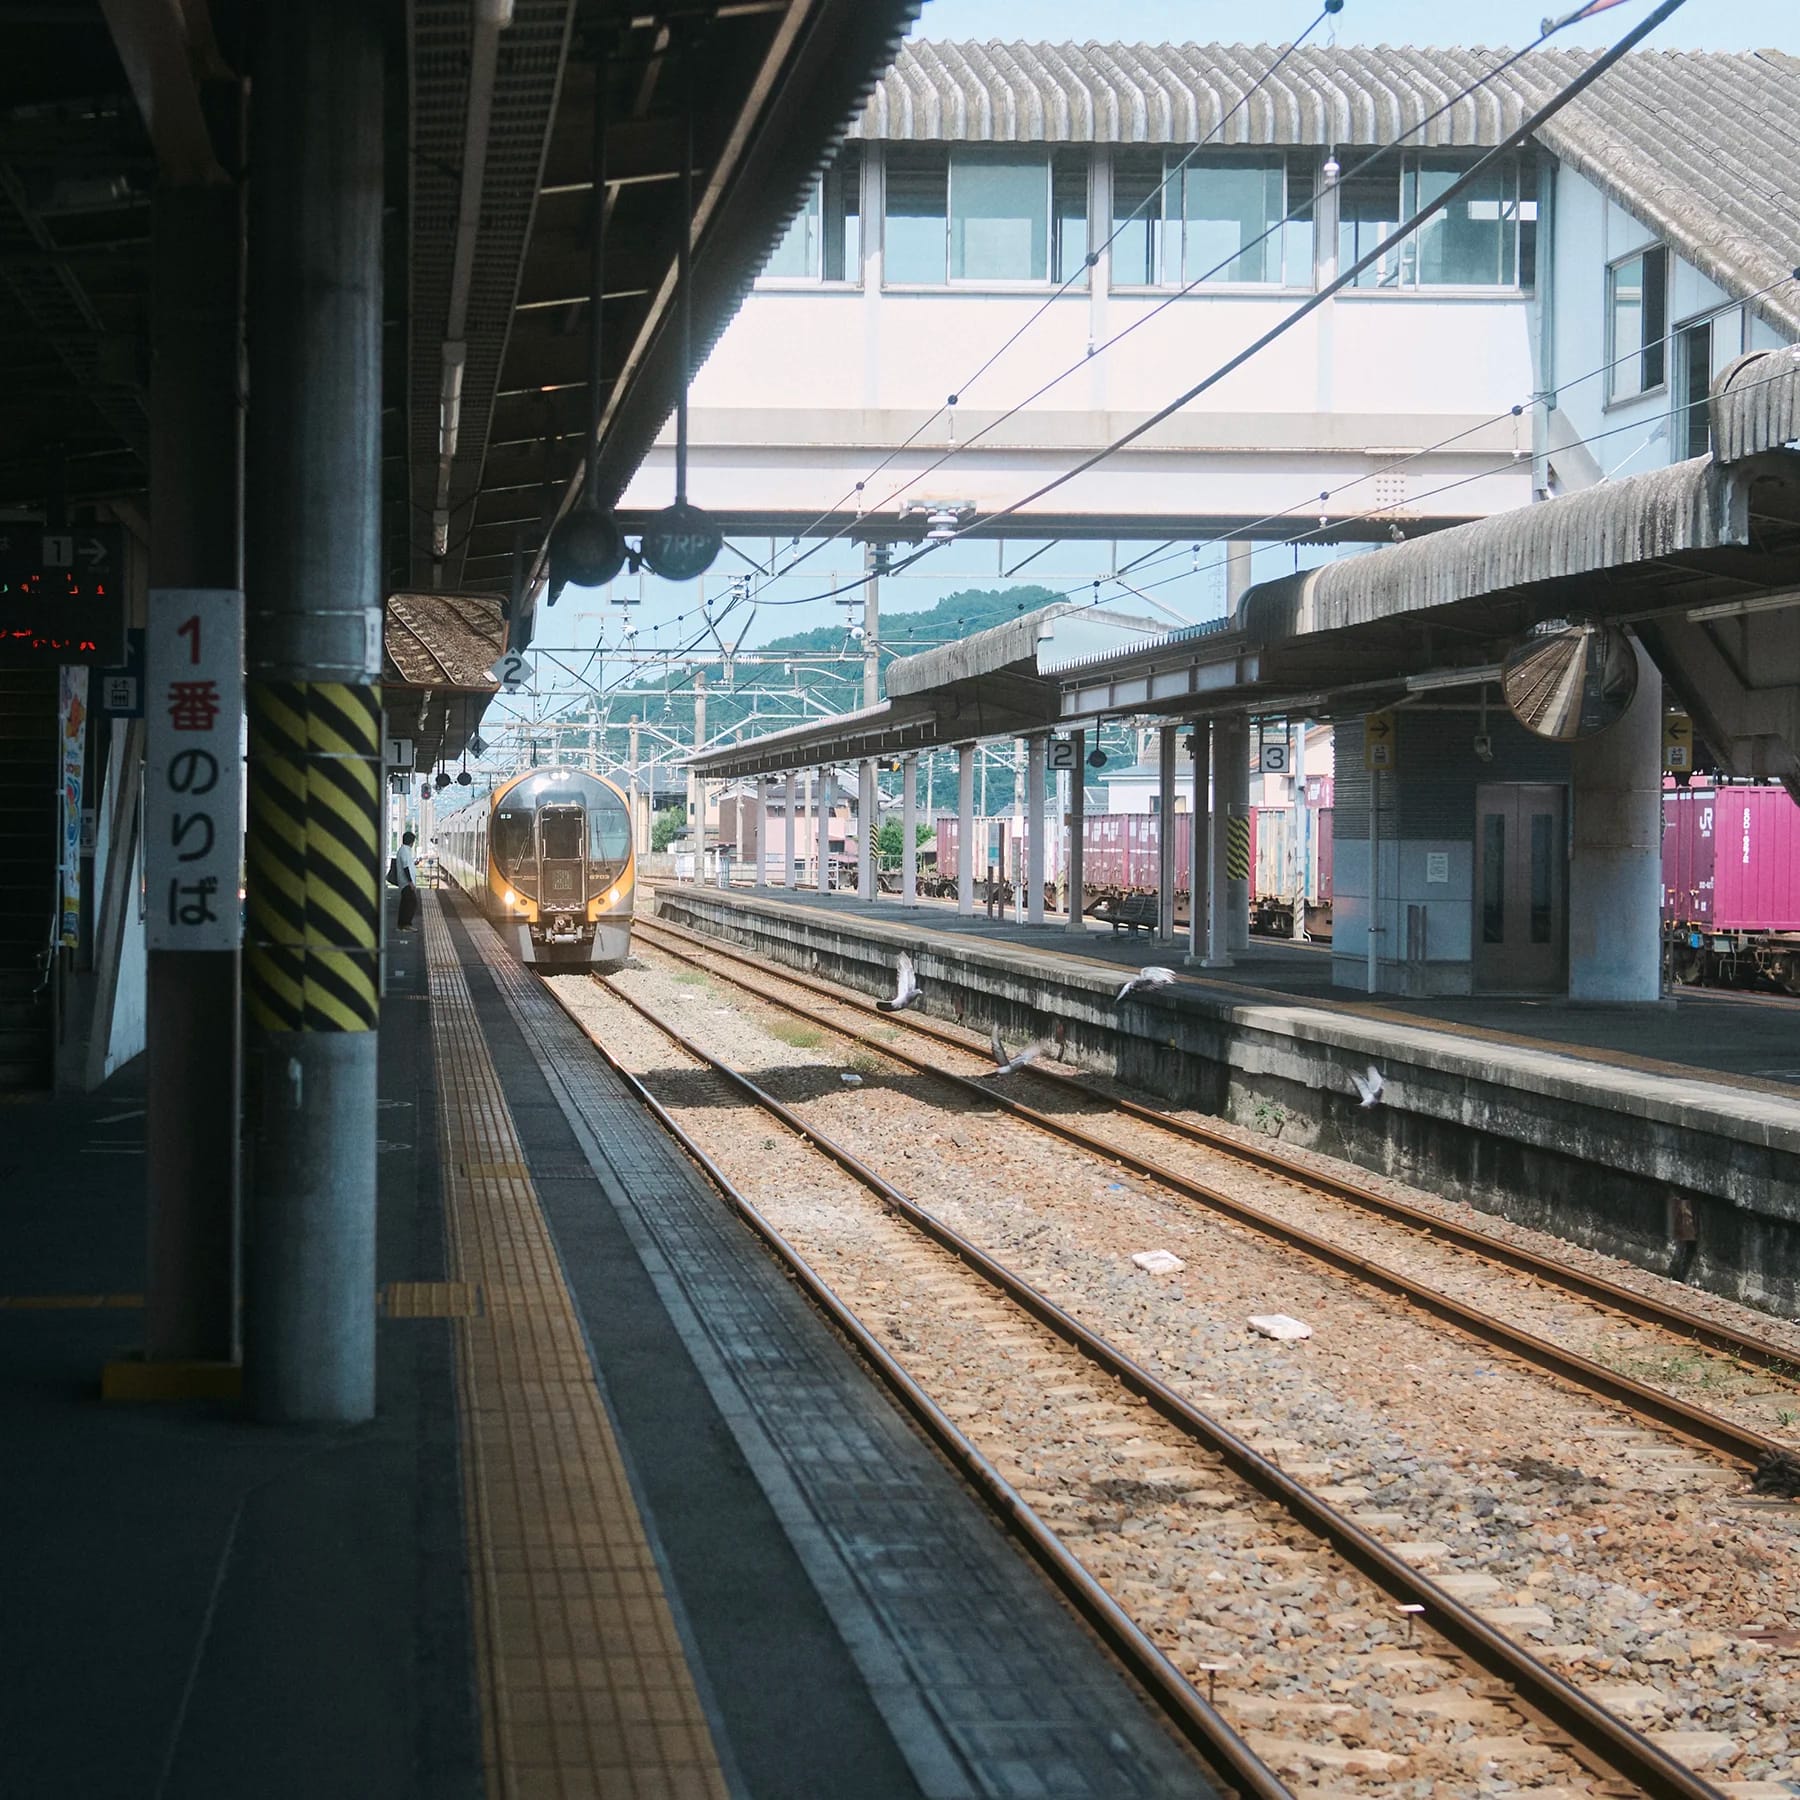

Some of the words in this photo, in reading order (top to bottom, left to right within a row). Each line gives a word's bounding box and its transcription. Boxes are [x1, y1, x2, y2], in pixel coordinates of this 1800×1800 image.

[503, 658, 522, 684] 2
[392, 742, 402, 764] 1
[471, 737, 481, 754] 4
[1053, 745, 1073, 766] 2
[1265, 747, 1284, 769] 3
[167, 615, 221, 927] 1番のりば
[1699, 807, 1713, 830] JR
